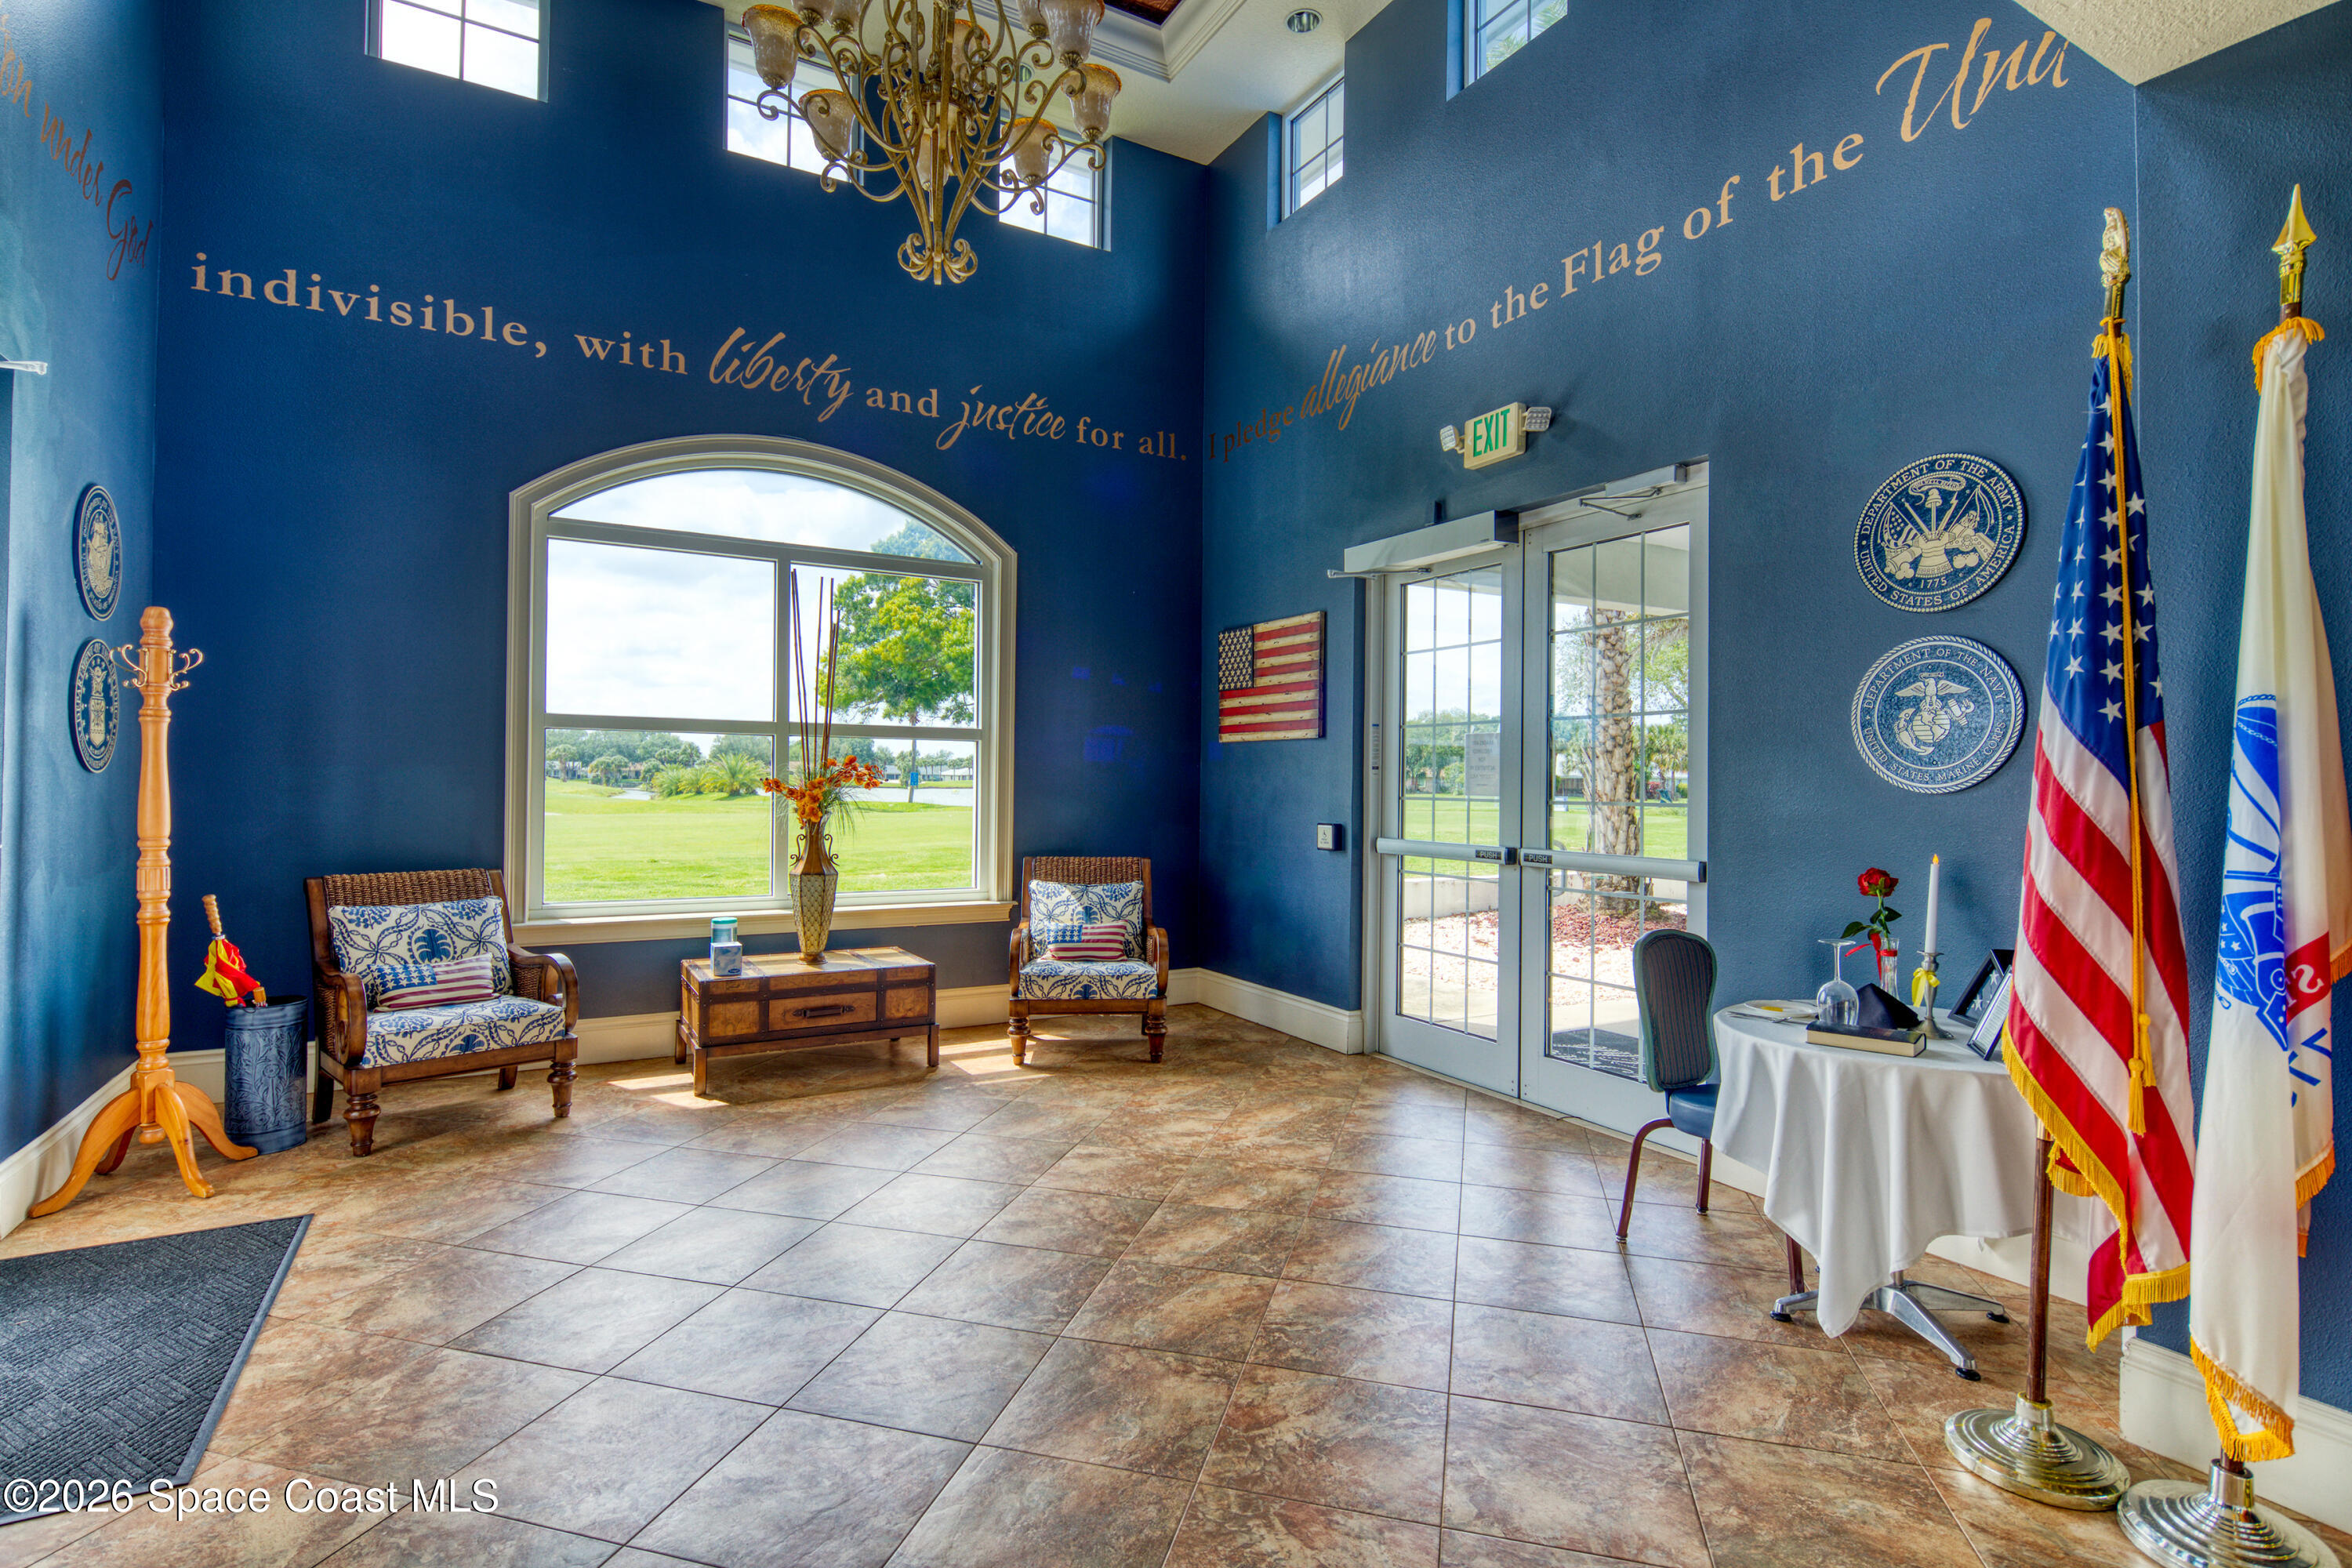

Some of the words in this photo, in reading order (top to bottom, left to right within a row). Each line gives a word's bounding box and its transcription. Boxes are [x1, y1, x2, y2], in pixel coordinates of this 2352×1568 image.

[40, 100, 104, 207] under
[106, 179, 154, 281] God
[1207, 433, 1216, 460] I
[1223, 405, 1294, 463] pledge
[1300, 330, 1437, 430] allegiance
[1445, 318, 1475, 350] to
[1490, 281, 1549, 329] the
[1561, 225, 1664, 299] Flag
[1682, 174, 1740, 240] of
[1766, 132, 1864, 201] the
[191, 252, 547, 358] indivisible,
[575, 331, 688, 376] with
[709, 326, 855, 423] liberty
[866, 387, 940, 418] and
[935, 384, 1066, 451] justice
[1076, 416, 1124, 450] for
[1138, 430, 1187, 461] all.
[1473, 408, 1511, 457] EXIT
[1862, 463, 1930, 535] DEPARTMENT
[1935, 459, 1956, 470] OF
[1960, 460, 1988, 478] THE
[1987, 475, 2014, 510] ARMY
[1860, 550, 1888, 592] UNITED
[1890, 590, 1943, 607] STATES
[1950, 584, 1970, 600] OF
[1975, 524, 2016, 587] AMERICA
[1921, 578, 1947, 589] 1775
[1864, 648, 1930, 709] DEPARTMENT
[1936, 648, 1951, 658] OF
[1958, 651, 1978, 666] THE
[1980, 666, 2007, 700] NAVY
[1864, 728, 1889, 762] UNITED
[1890, 763, 1929, 782] STATES
[1937, 757, 1983, 782] MARINE
[1983, 721, 2007, 756] CORPS
[1479, 851, 1497, 859] PUSH
[1528, 854, 1548, 862] PUSH
